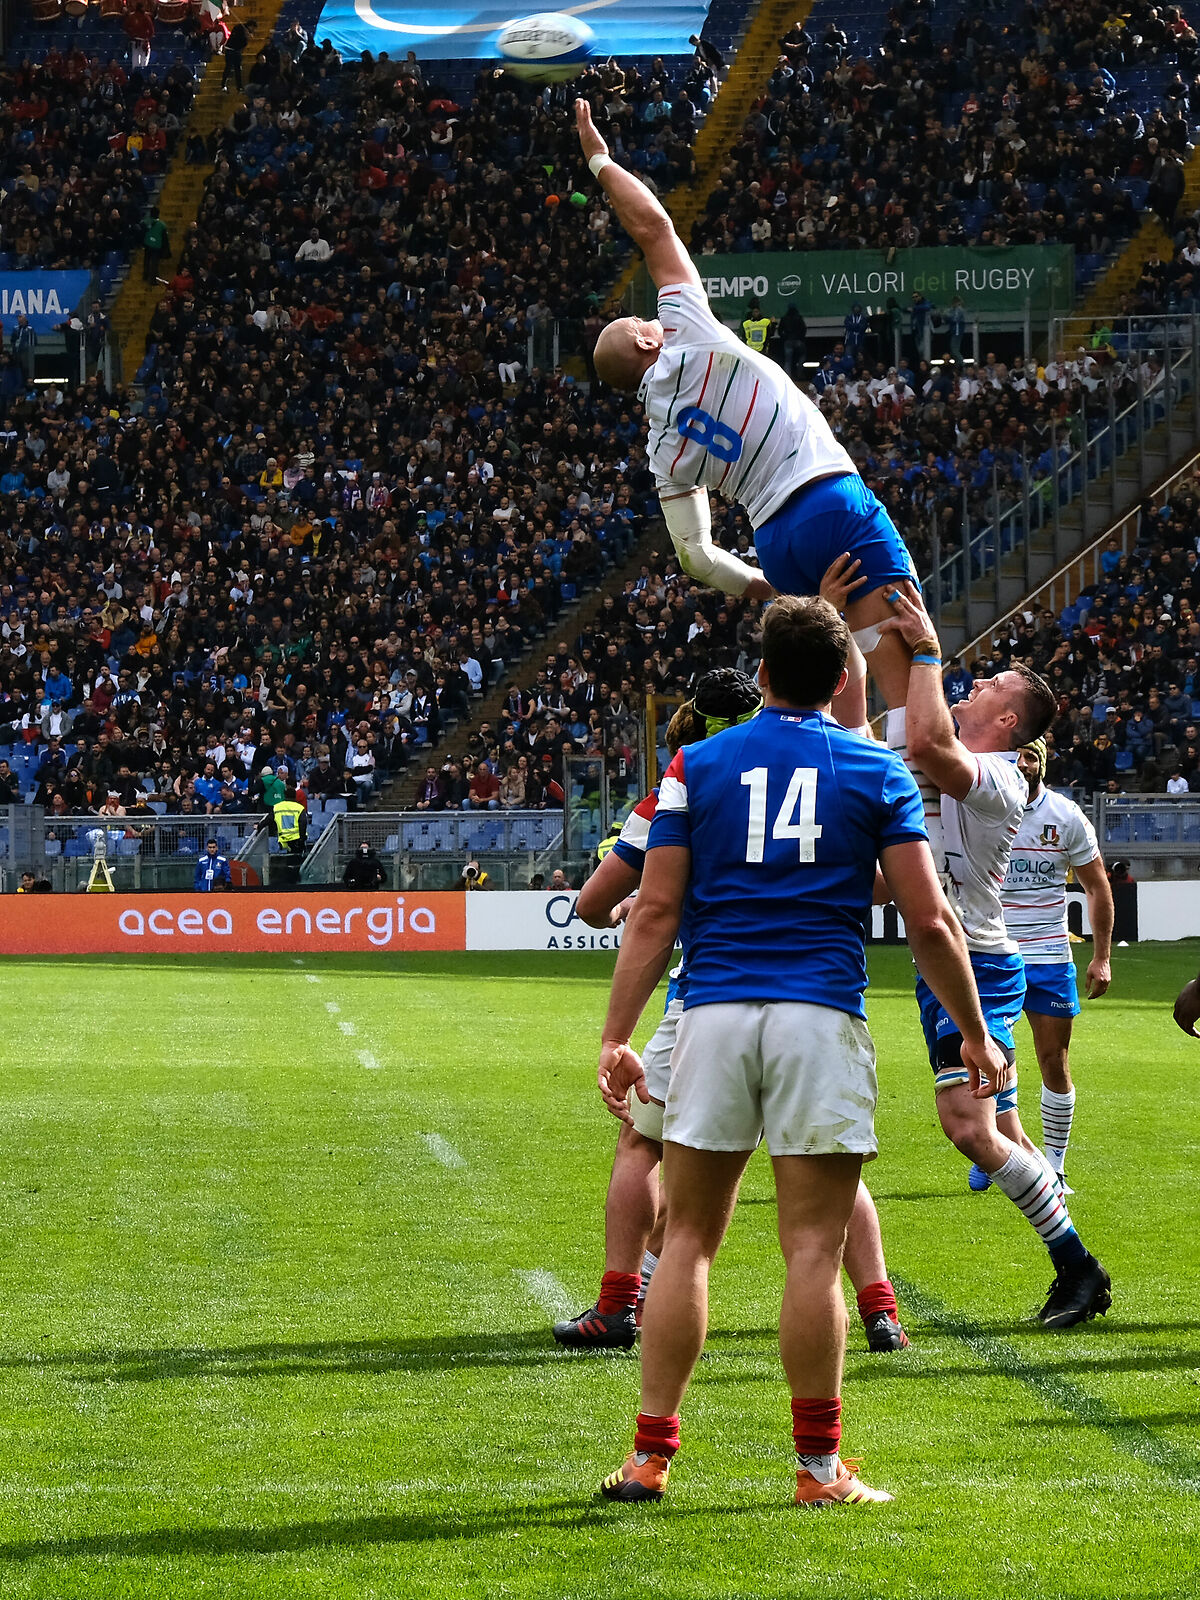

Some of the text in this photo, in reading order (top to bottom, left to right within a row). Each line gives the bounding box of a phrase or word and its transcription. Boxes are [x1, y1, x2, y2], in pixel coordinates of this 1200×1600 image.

[821, 271, 905, 294] VALORI
[913, 271, 947, 292] del
[955, 268, 1035, 291] RUGBY
[0, 289, 70, 315] IANA.
[677, 406, 743, 463] 8
[741, 767, 823, 863] 14
[1008, 859, 1056, 874] TOLICA
[118, 896, 436, 945] acea energia
[546, 934, 622, 949] ASSICU
